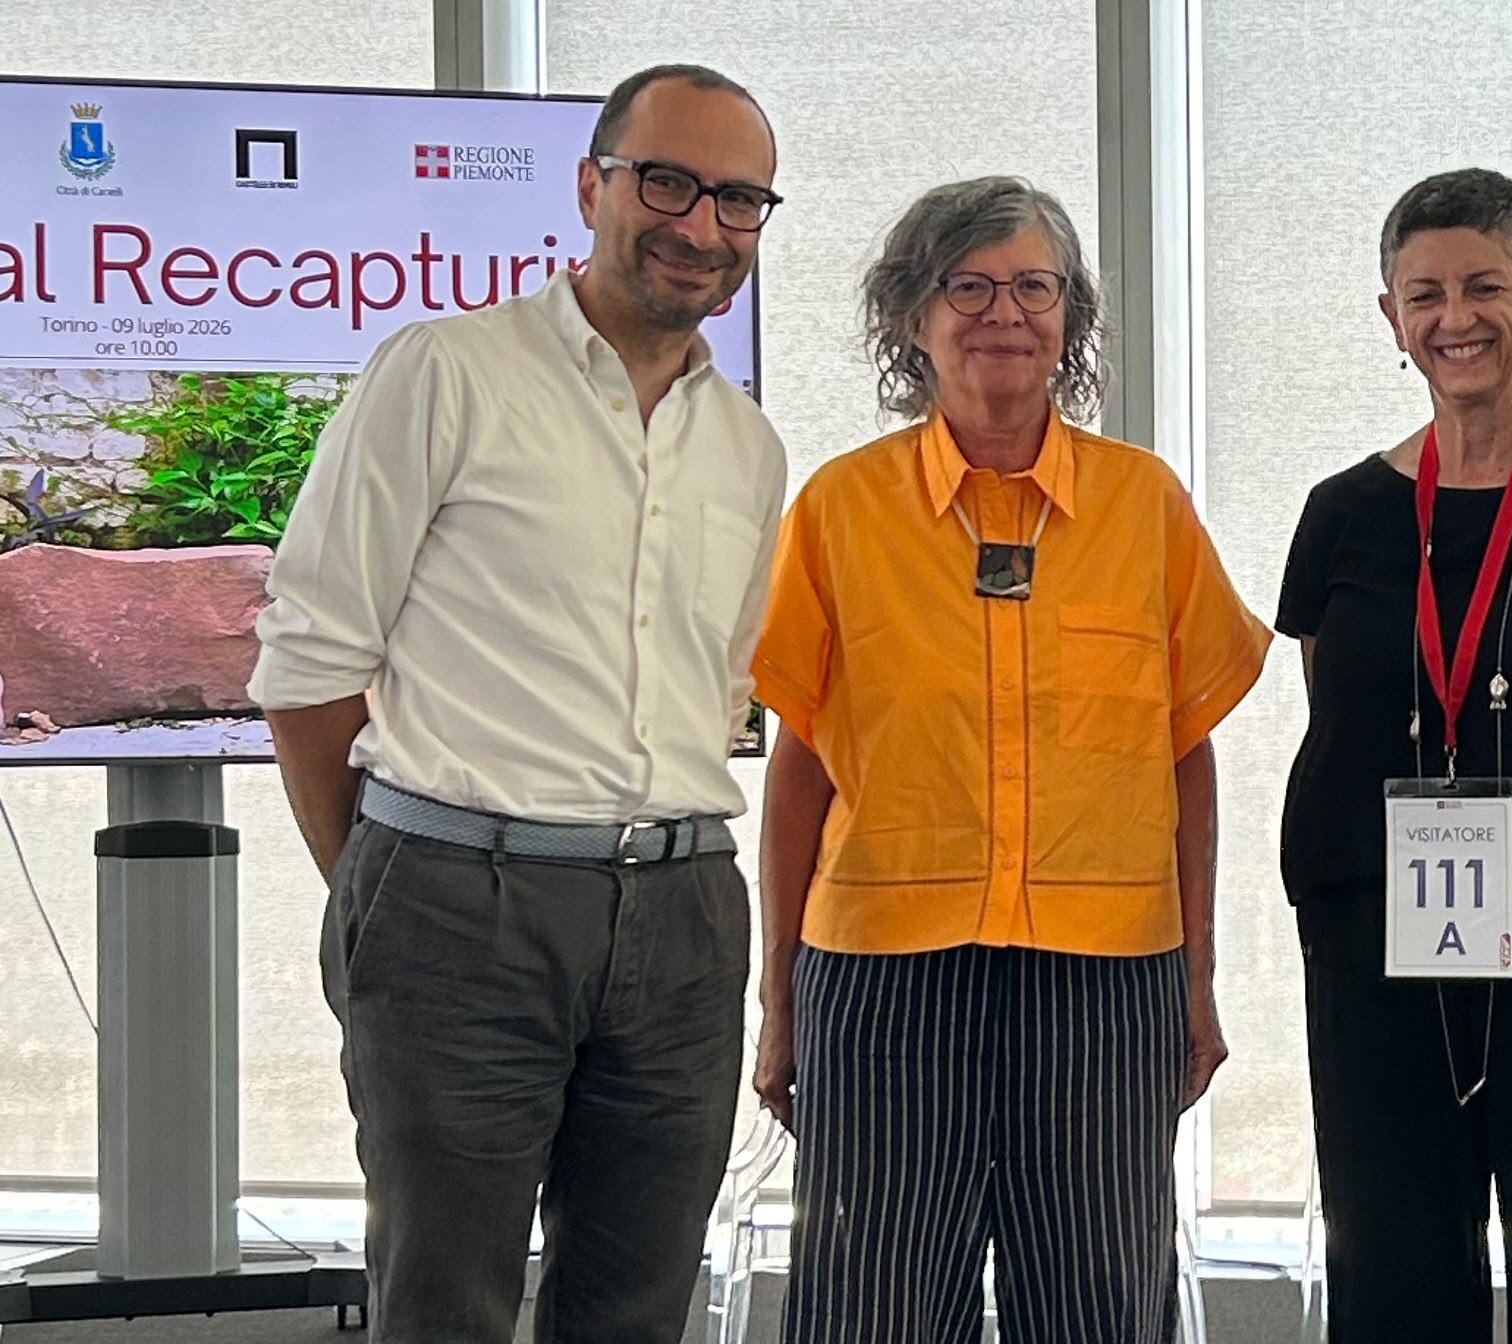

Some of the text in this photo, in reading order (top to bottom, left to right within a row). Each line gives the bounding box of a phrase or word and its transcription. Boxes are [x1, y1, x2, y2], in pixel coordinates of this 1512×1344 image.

[453, 147, 534, 165] REGIONE
[453, 165, 534, 181] PIEMONTE
[41, 316, 98, 334] Torino
[112, 318, 134, 334] 09
[138, 318, 183, 337] luglio
[188, 320, 231, 335] 2026
[95, 340, 178, 356] ore 10.00
[1406, 827, 1495, 842] VISITATORE
[1408, 859, 1484, 908] 111
[1435, 921, 1466, 955] A
